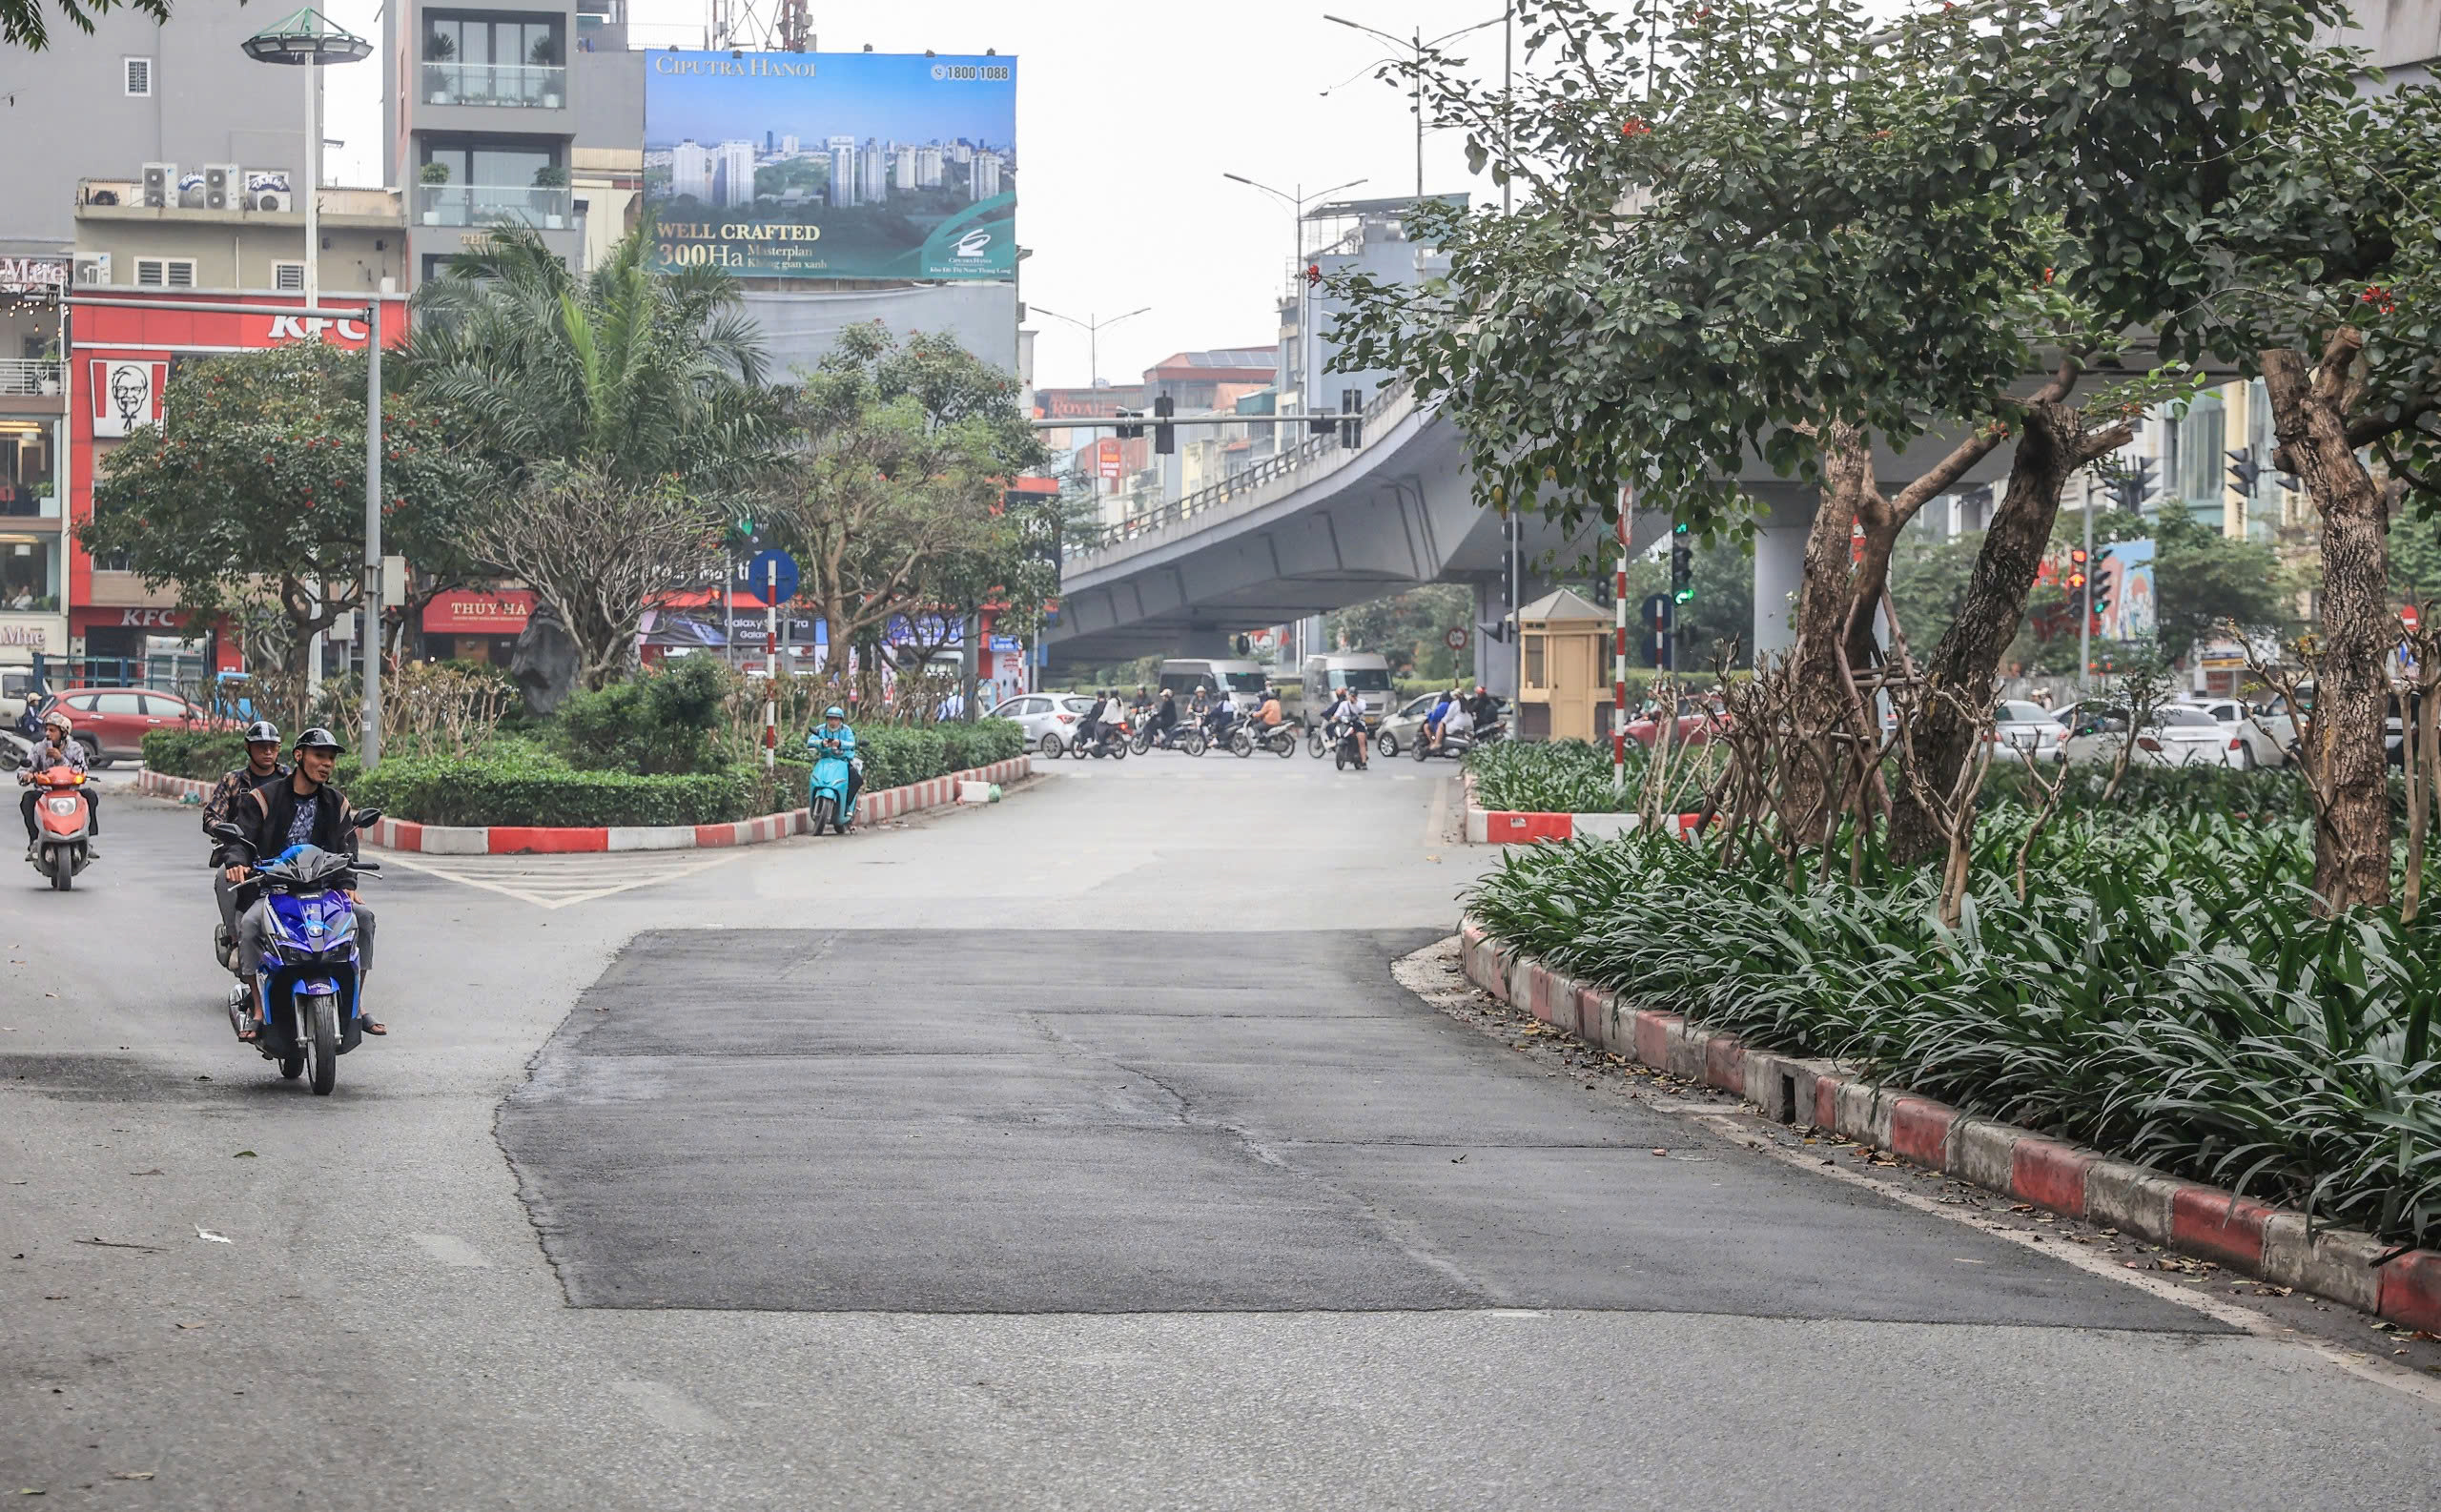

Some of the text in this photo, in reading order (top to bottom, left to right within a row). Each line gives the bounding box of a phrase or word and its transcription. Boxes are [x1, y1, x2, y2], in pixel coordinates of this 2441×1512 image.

[656, 55, 817, 77] CIPUTRA HANOI
[948, 66, 1008, 79] 1800 1088
[656, 222, 821, 241] WELL CRAFTED
[659, 244, 744, 267] 300Ha
[748, 244, 813, 261] Masterplan
[268, 315, 366, 339] KFC
[121, 609, 176, 626] KFC
